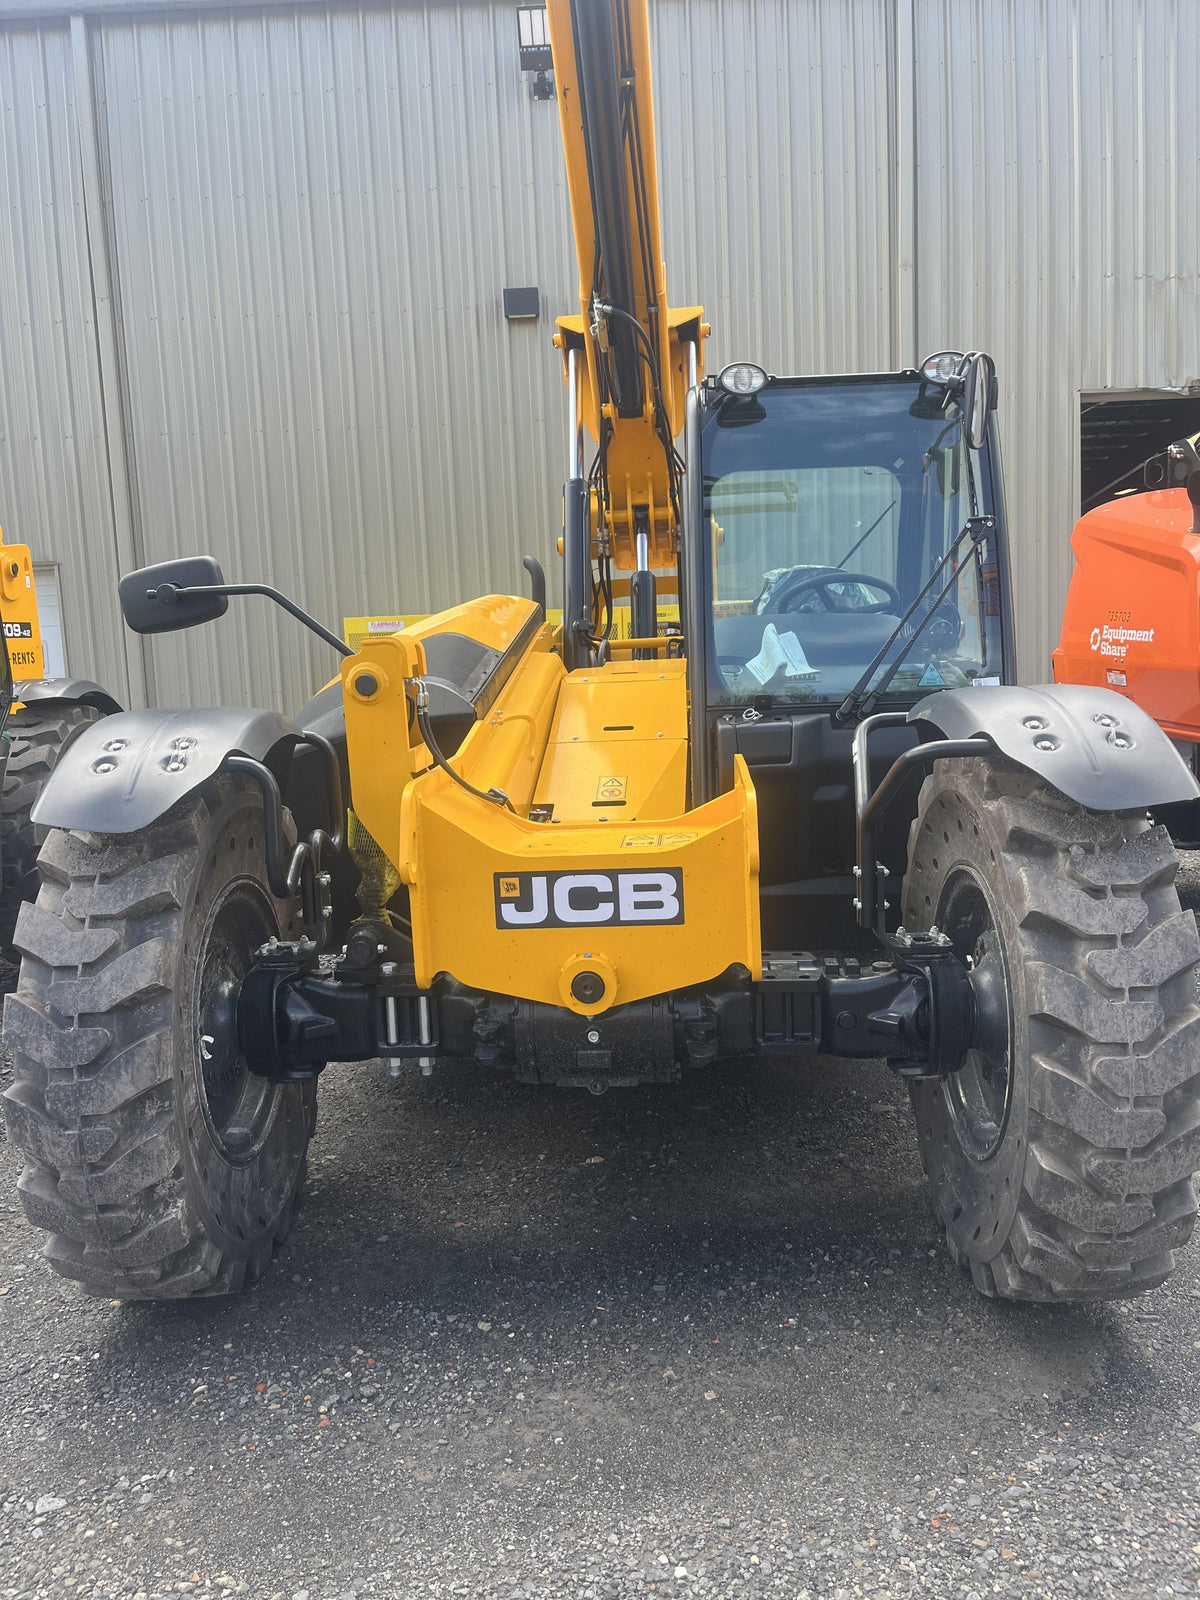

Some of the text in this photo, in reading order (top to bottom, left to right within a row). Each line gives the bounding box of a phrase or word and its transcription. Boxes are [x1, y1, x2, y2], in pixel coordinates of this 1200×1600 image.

[1106, 611, 1131, 622] 735703
[1101, 625, 1155, 643] Equipment
[501, 872, 680, 924] JCB
